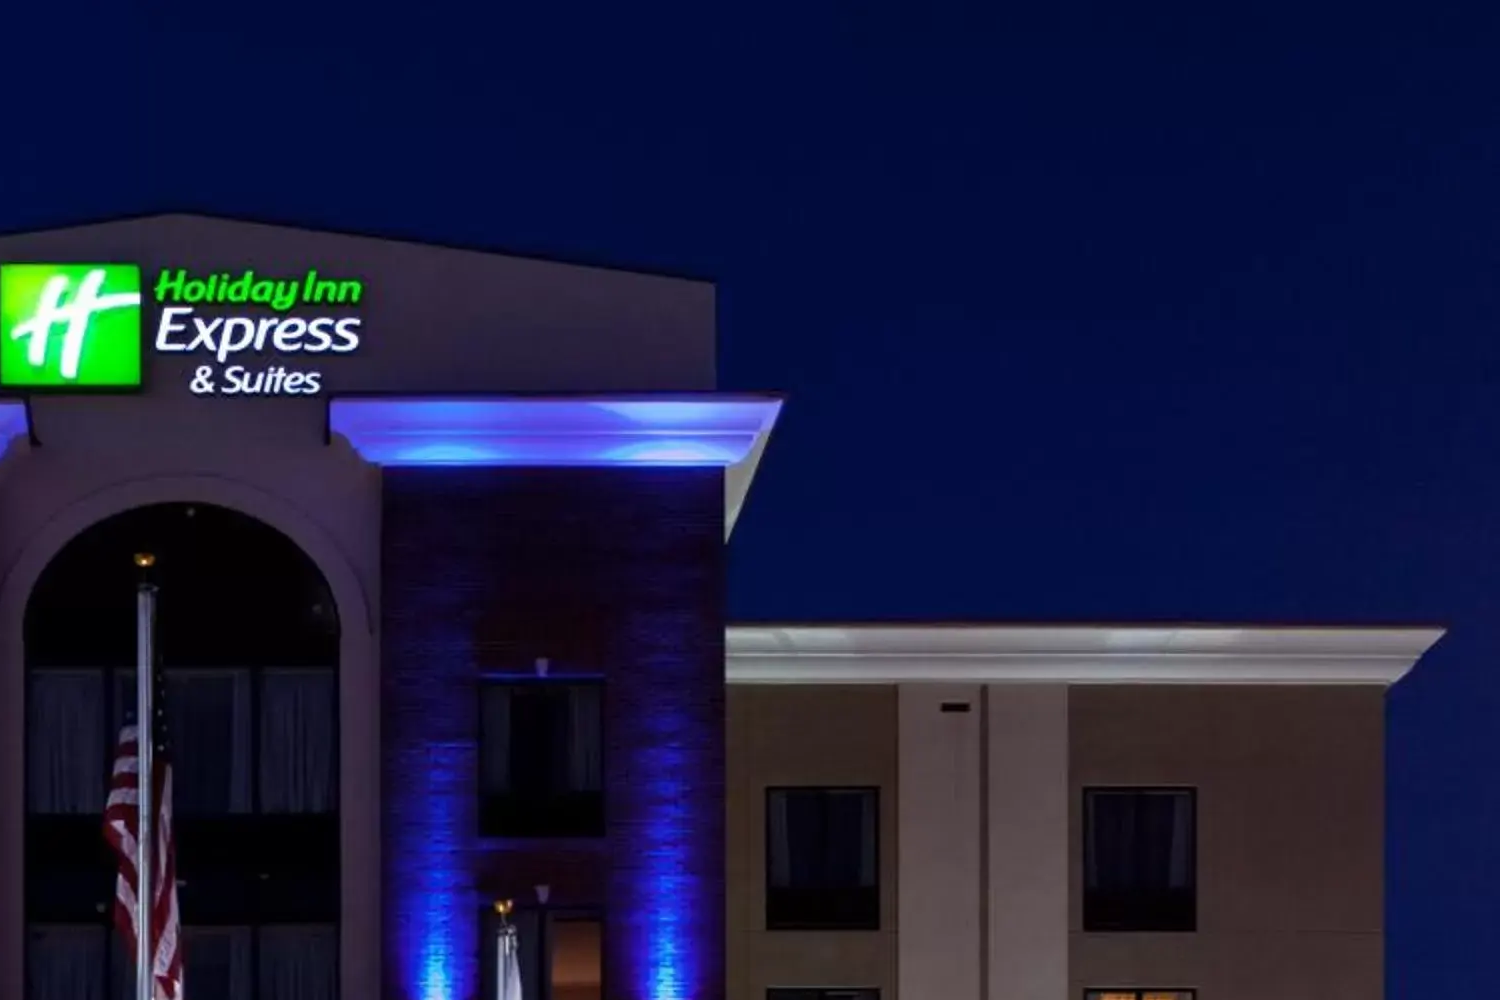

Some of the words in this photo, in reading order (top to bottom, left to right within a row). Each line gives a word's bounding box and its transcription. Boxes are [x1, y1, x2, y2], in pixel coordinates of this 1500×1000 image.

[154, 269, 299, 311] Holiday
[302, 269, 362, 304] Inn
[155, 306, 361, 363] Express
[189, 365, 215, 394] &
[221, 365, 321, 394] Suites
